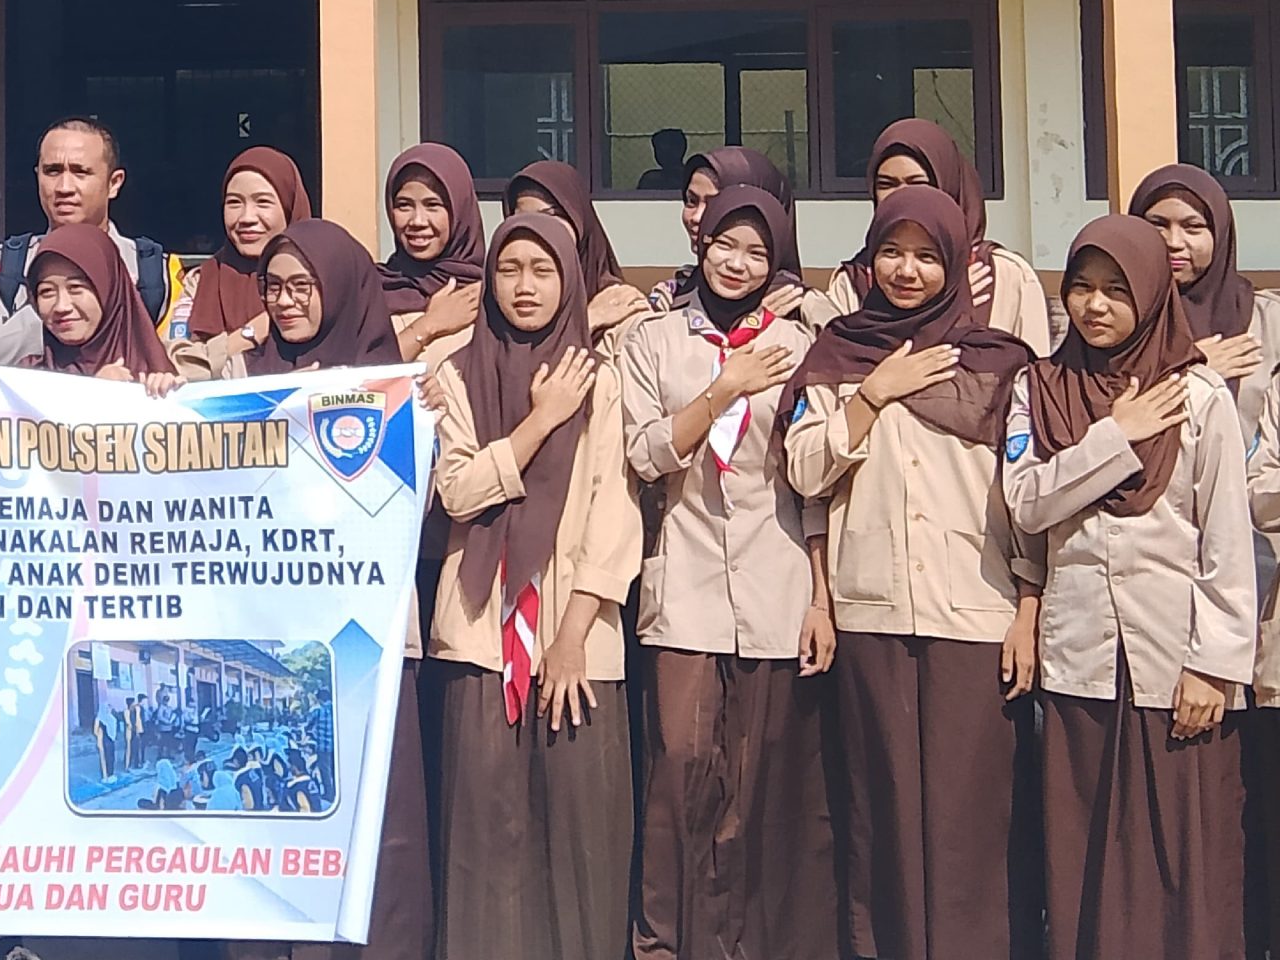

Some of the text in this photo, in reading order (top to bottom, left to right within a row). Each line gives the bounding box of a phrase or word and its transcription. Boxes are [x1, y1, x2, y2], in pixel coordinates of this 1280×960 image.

[321, 393, 375, 407] BINMAS
[18, 417, 139, 474] POLSEK
[142, 420, 289, 473] SIANTAN
[98, 501, 153, 523] DAN
[164, 496, 273, 522] WANITA
[130, 529, 250, 557] REMAJA,
[262, 529, 344, 558] KDRT,
[8, 562, 83, 586] ANAK
[95, 563, 160, 586] DEMI
[172, 561, 385, 585] TERWUJUDNYA
[18, 595, 71, 619] DAN
[84, 595, 182, 619] TERTIB
[86, 846, 271, 875] PERGAULAN
[281, 848, 347, 876] BEB
[46, 884, 108, 910] DAN
[118, 884, 207, 912] GURU
